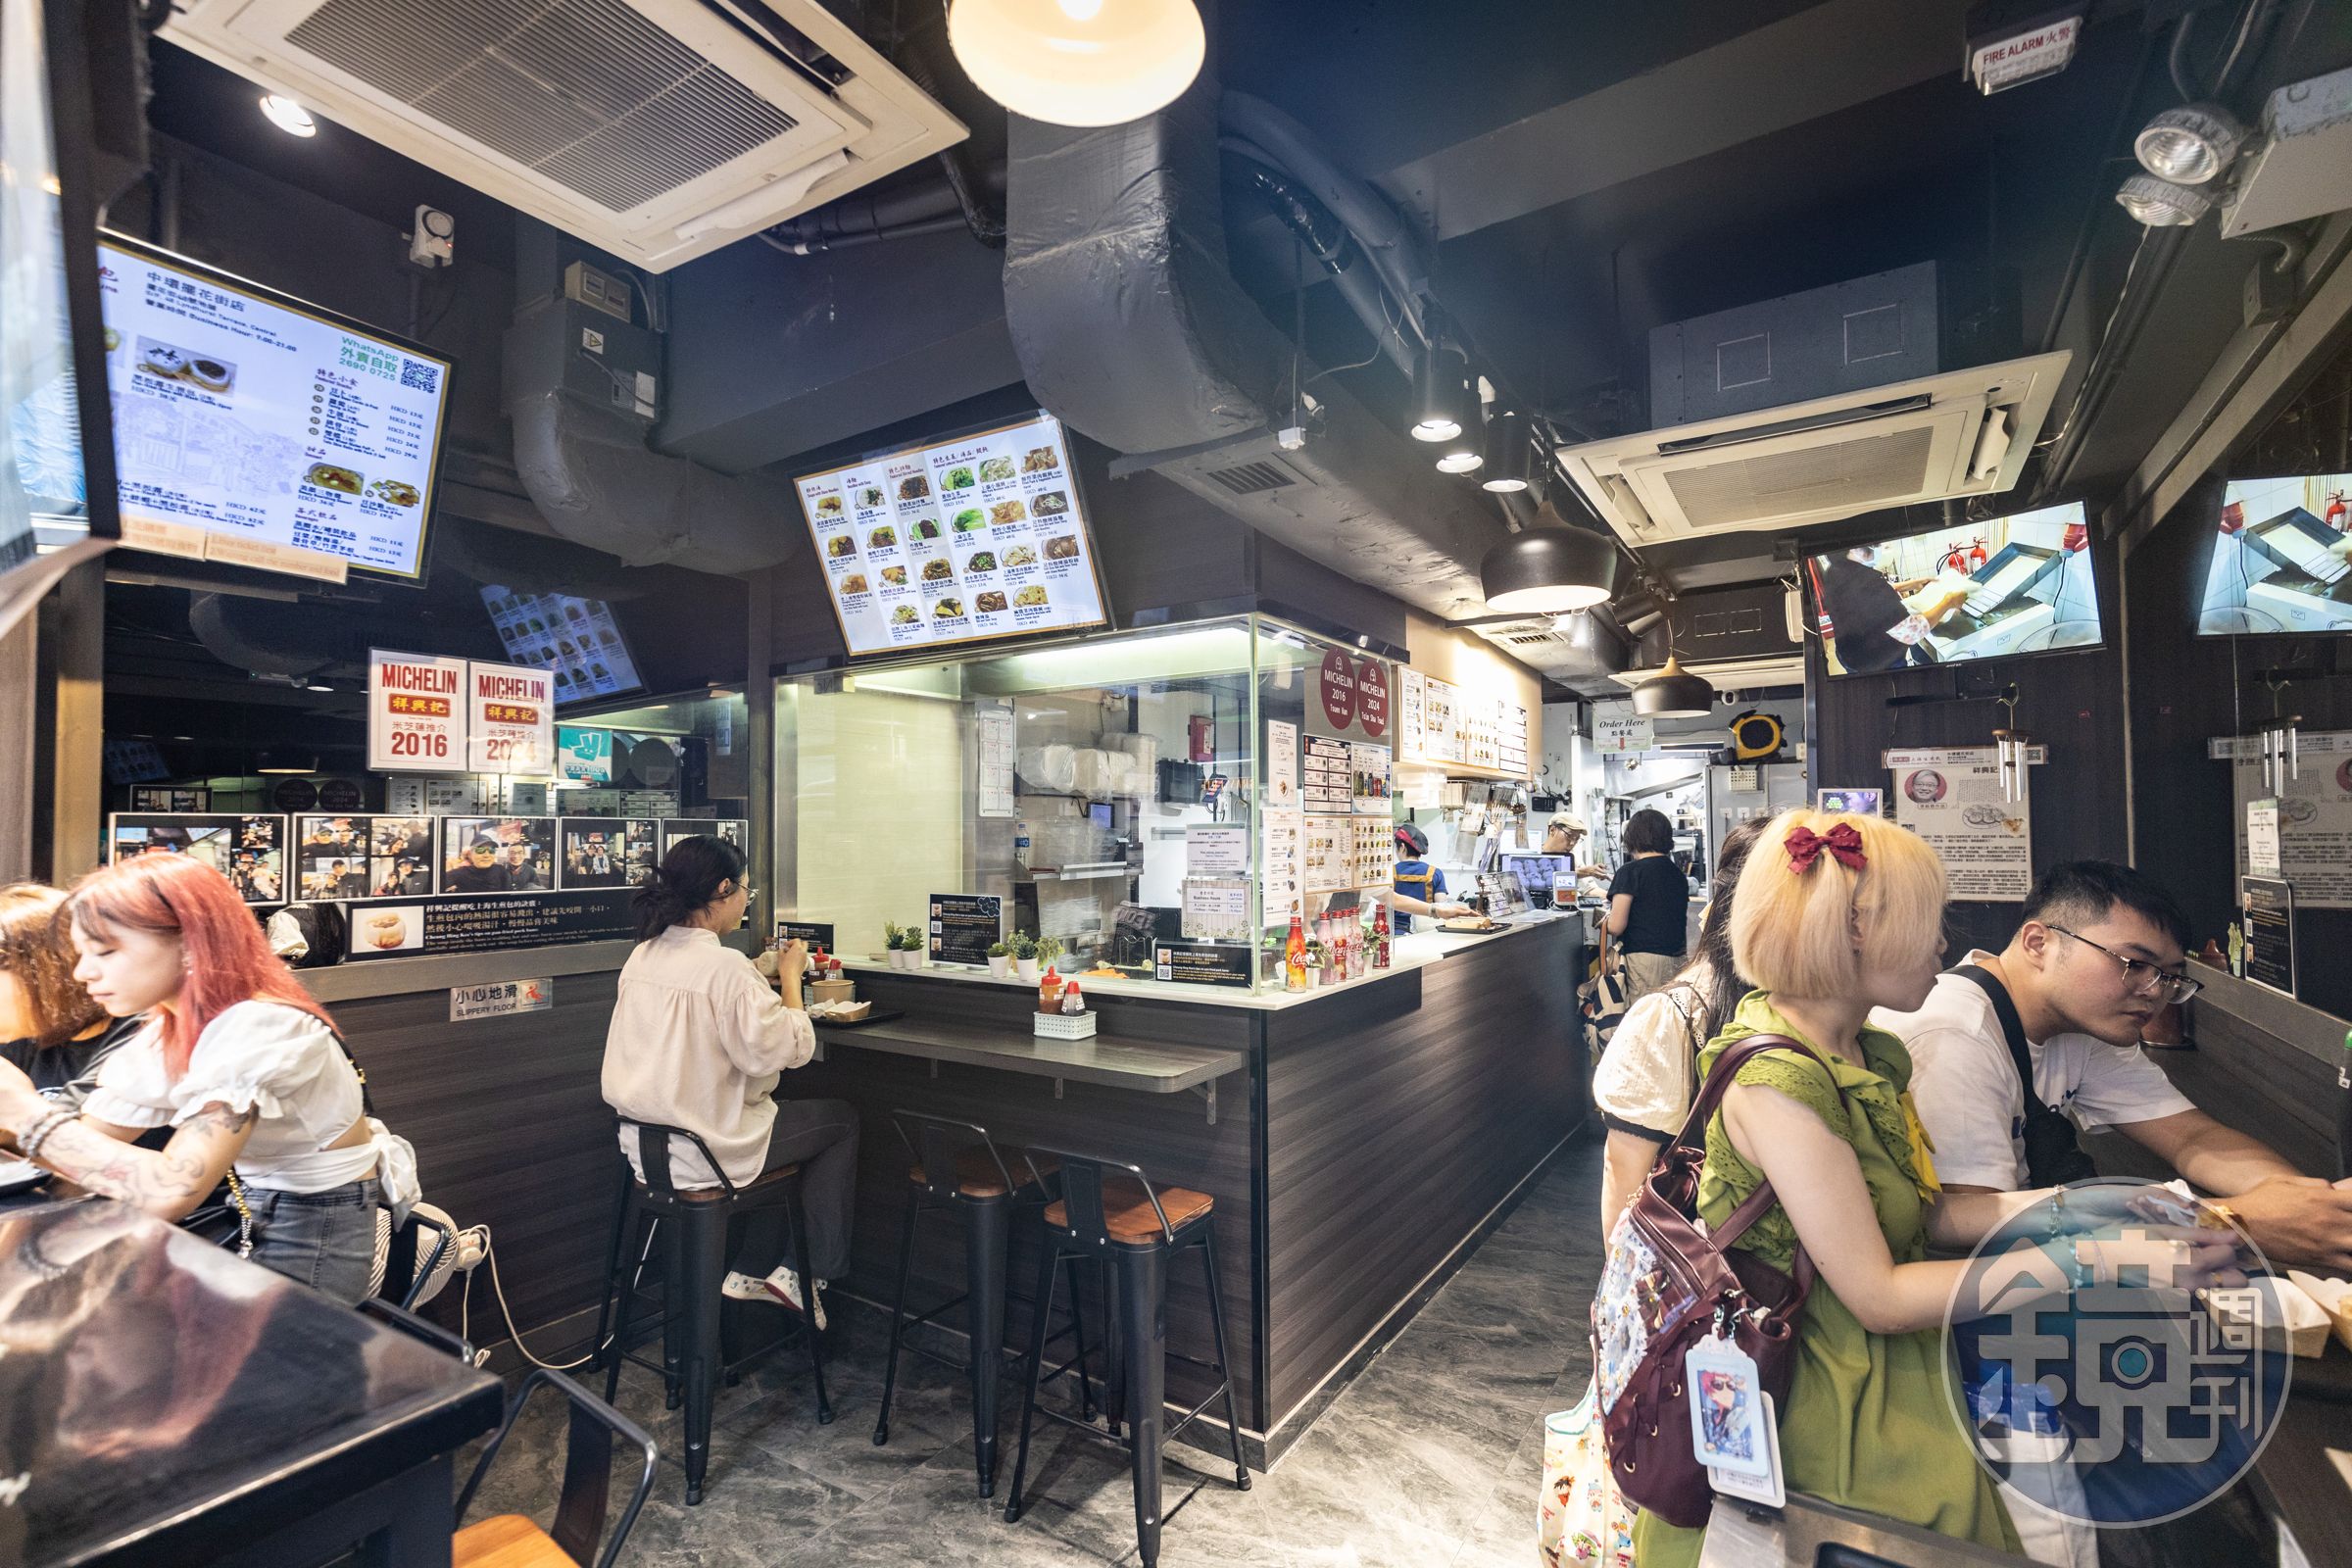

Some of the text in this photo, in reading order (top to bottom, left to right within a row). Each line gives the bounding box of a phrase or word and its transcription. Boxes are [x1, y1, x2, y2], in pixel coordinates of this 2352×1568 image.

[1984, 25, 2071, 66] FIRE ALARM 火警
[341, 336, 399, 362] WhatsApp
[340, 346, 398, 373] 外賣自取
[368, 368, 396, 381] 0725
[382, 663, 458, 694] MICHELIN
[478, 674, 546, 703] MICHELIN
[1324, 669, 1353, 689] MICHELIN
[1332, 688, 1347, 702] 2016
[1359, 680, 1386, 699] MICHELIN
[392, 697, 448, 713] 祥興記
[488, 706, 536, 721] 祥興記
[1367, 698, 1380, 711] 2024
[392, 720, 447, 733] 米芝蓮推介
[391, 731, 448, 758] 2016
[486, 738, 537, 761] 204
[455, 984, 518, 1005] 小心地滑
[456, 1003, 517, 1018] SLIPPERY FLOOR
